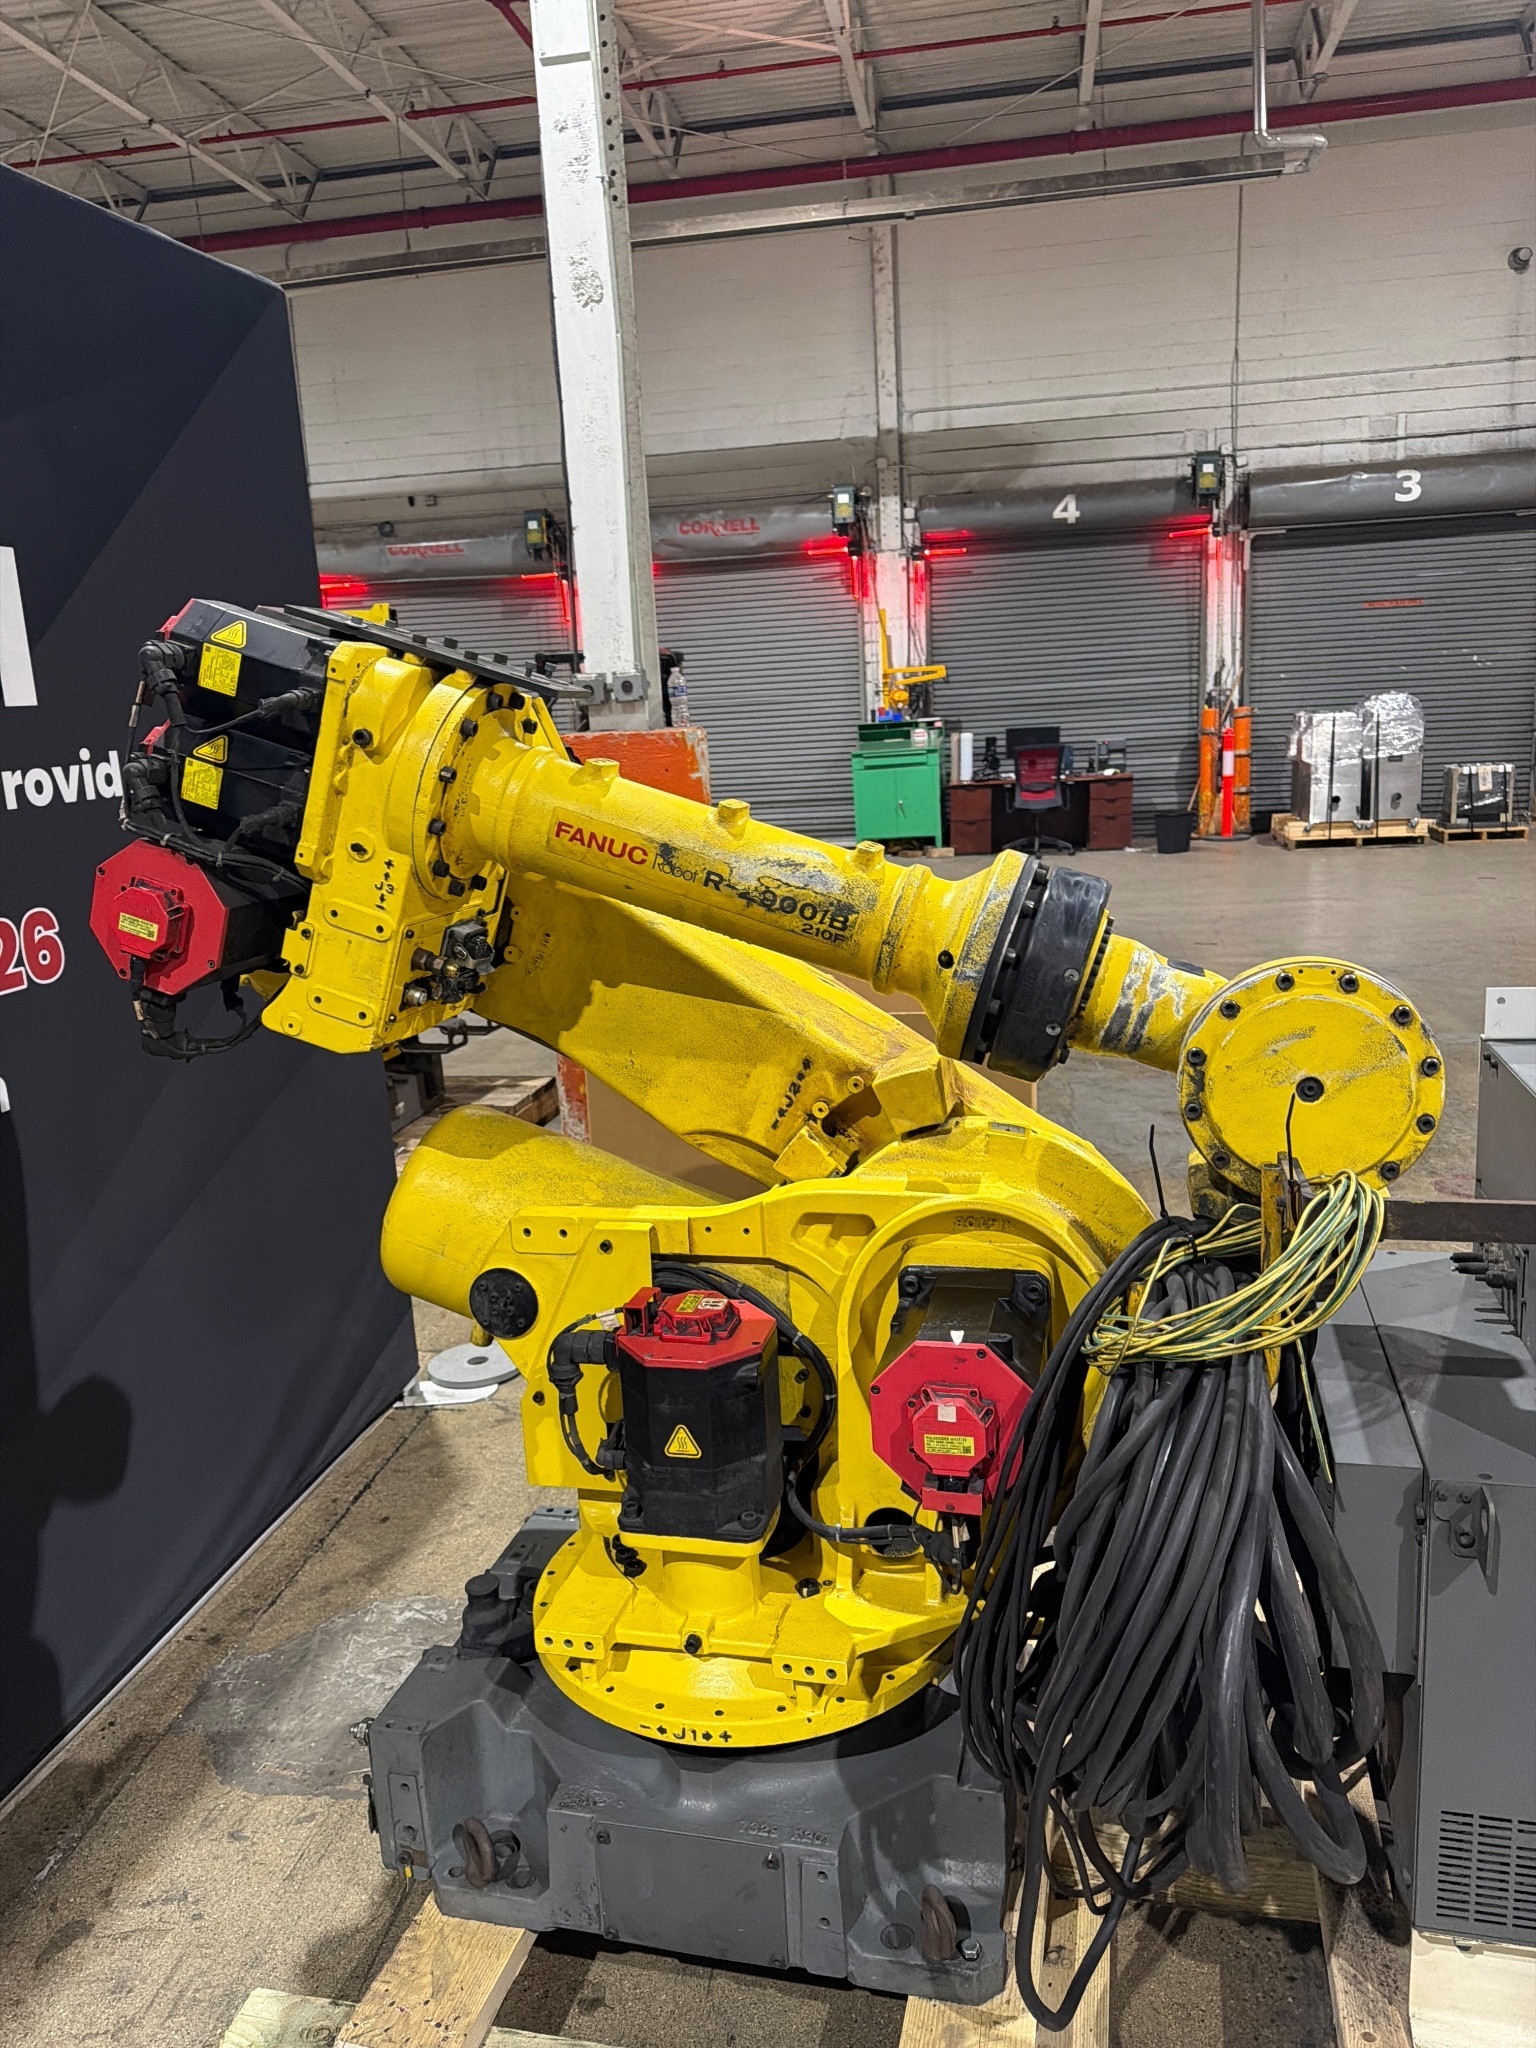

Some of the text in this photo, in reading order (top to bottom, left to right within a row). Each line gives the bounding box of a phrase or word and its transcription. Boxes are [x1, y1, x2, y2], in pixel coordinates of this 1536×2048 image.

[1394, 469, 1422, 502] 3
[1052, 494, 1081, 524] 4
[554, 820, 649, 865] FANUC
[651, 852, 699, 884] Robot
